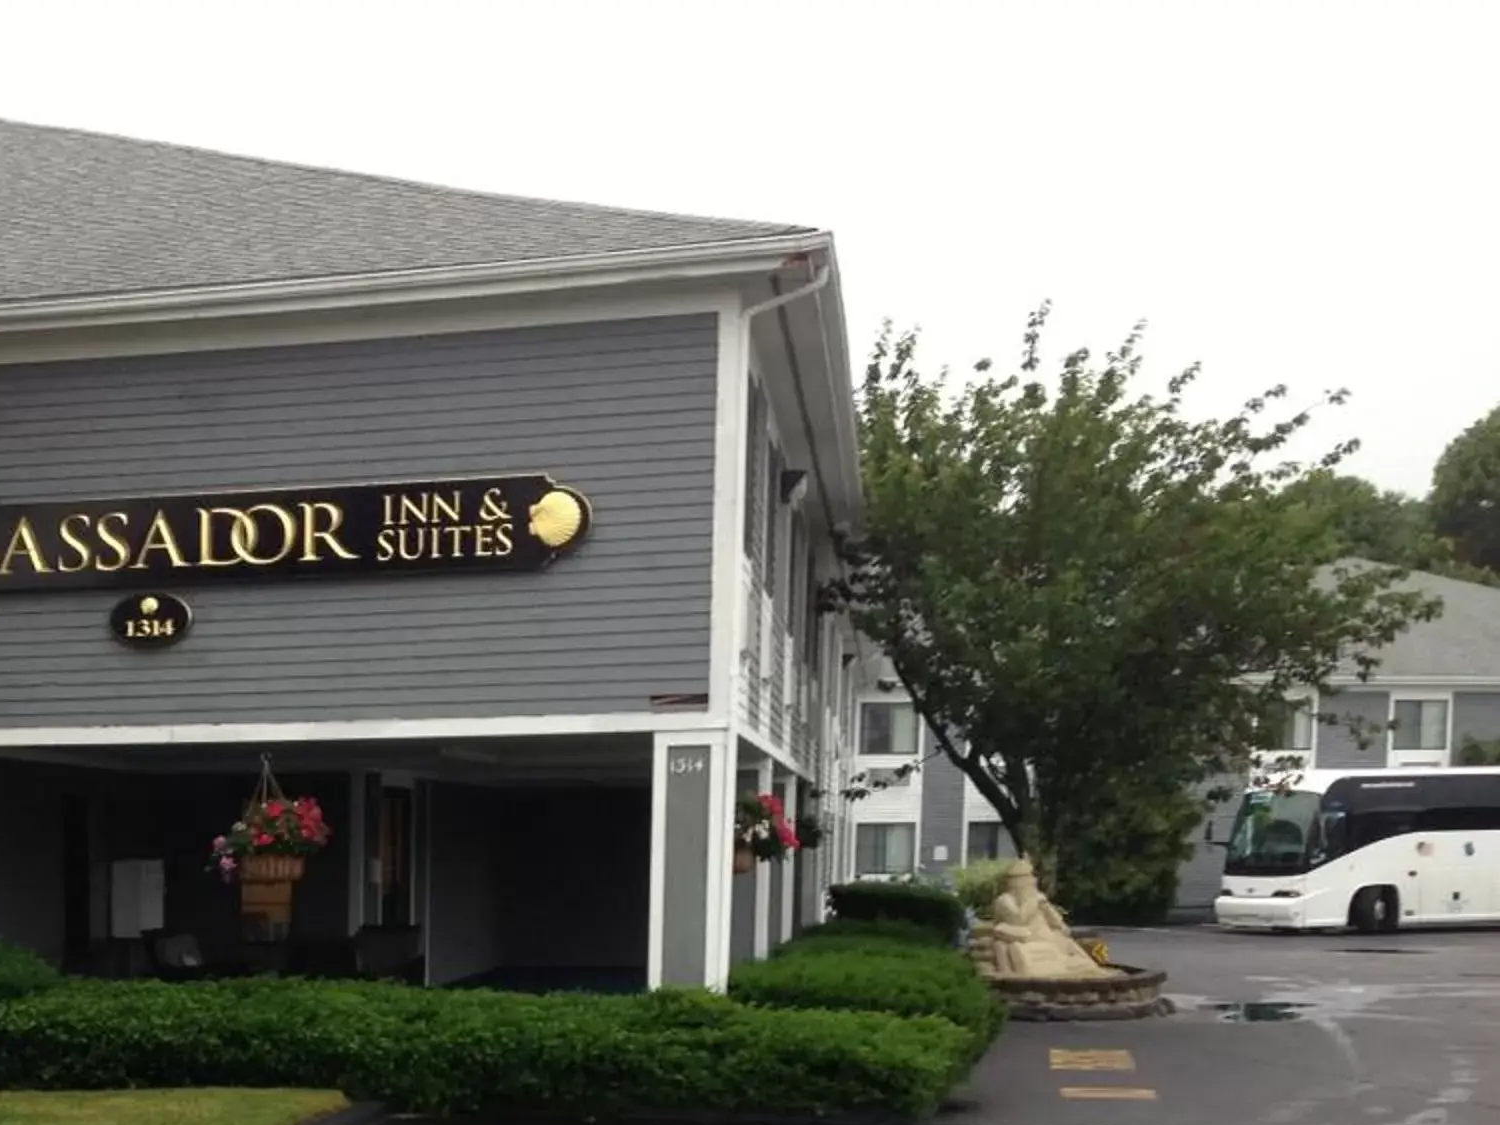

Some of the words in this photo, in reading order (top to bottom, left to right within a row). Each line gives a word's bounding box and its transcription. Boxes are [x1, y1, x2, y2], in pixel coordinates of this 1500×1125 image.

[382, 490, 461, 526] INN
[478, 486, 514, 522] &
[376, 523, 515, 562] SUITES
[124, 618, 177, 638] 1314
